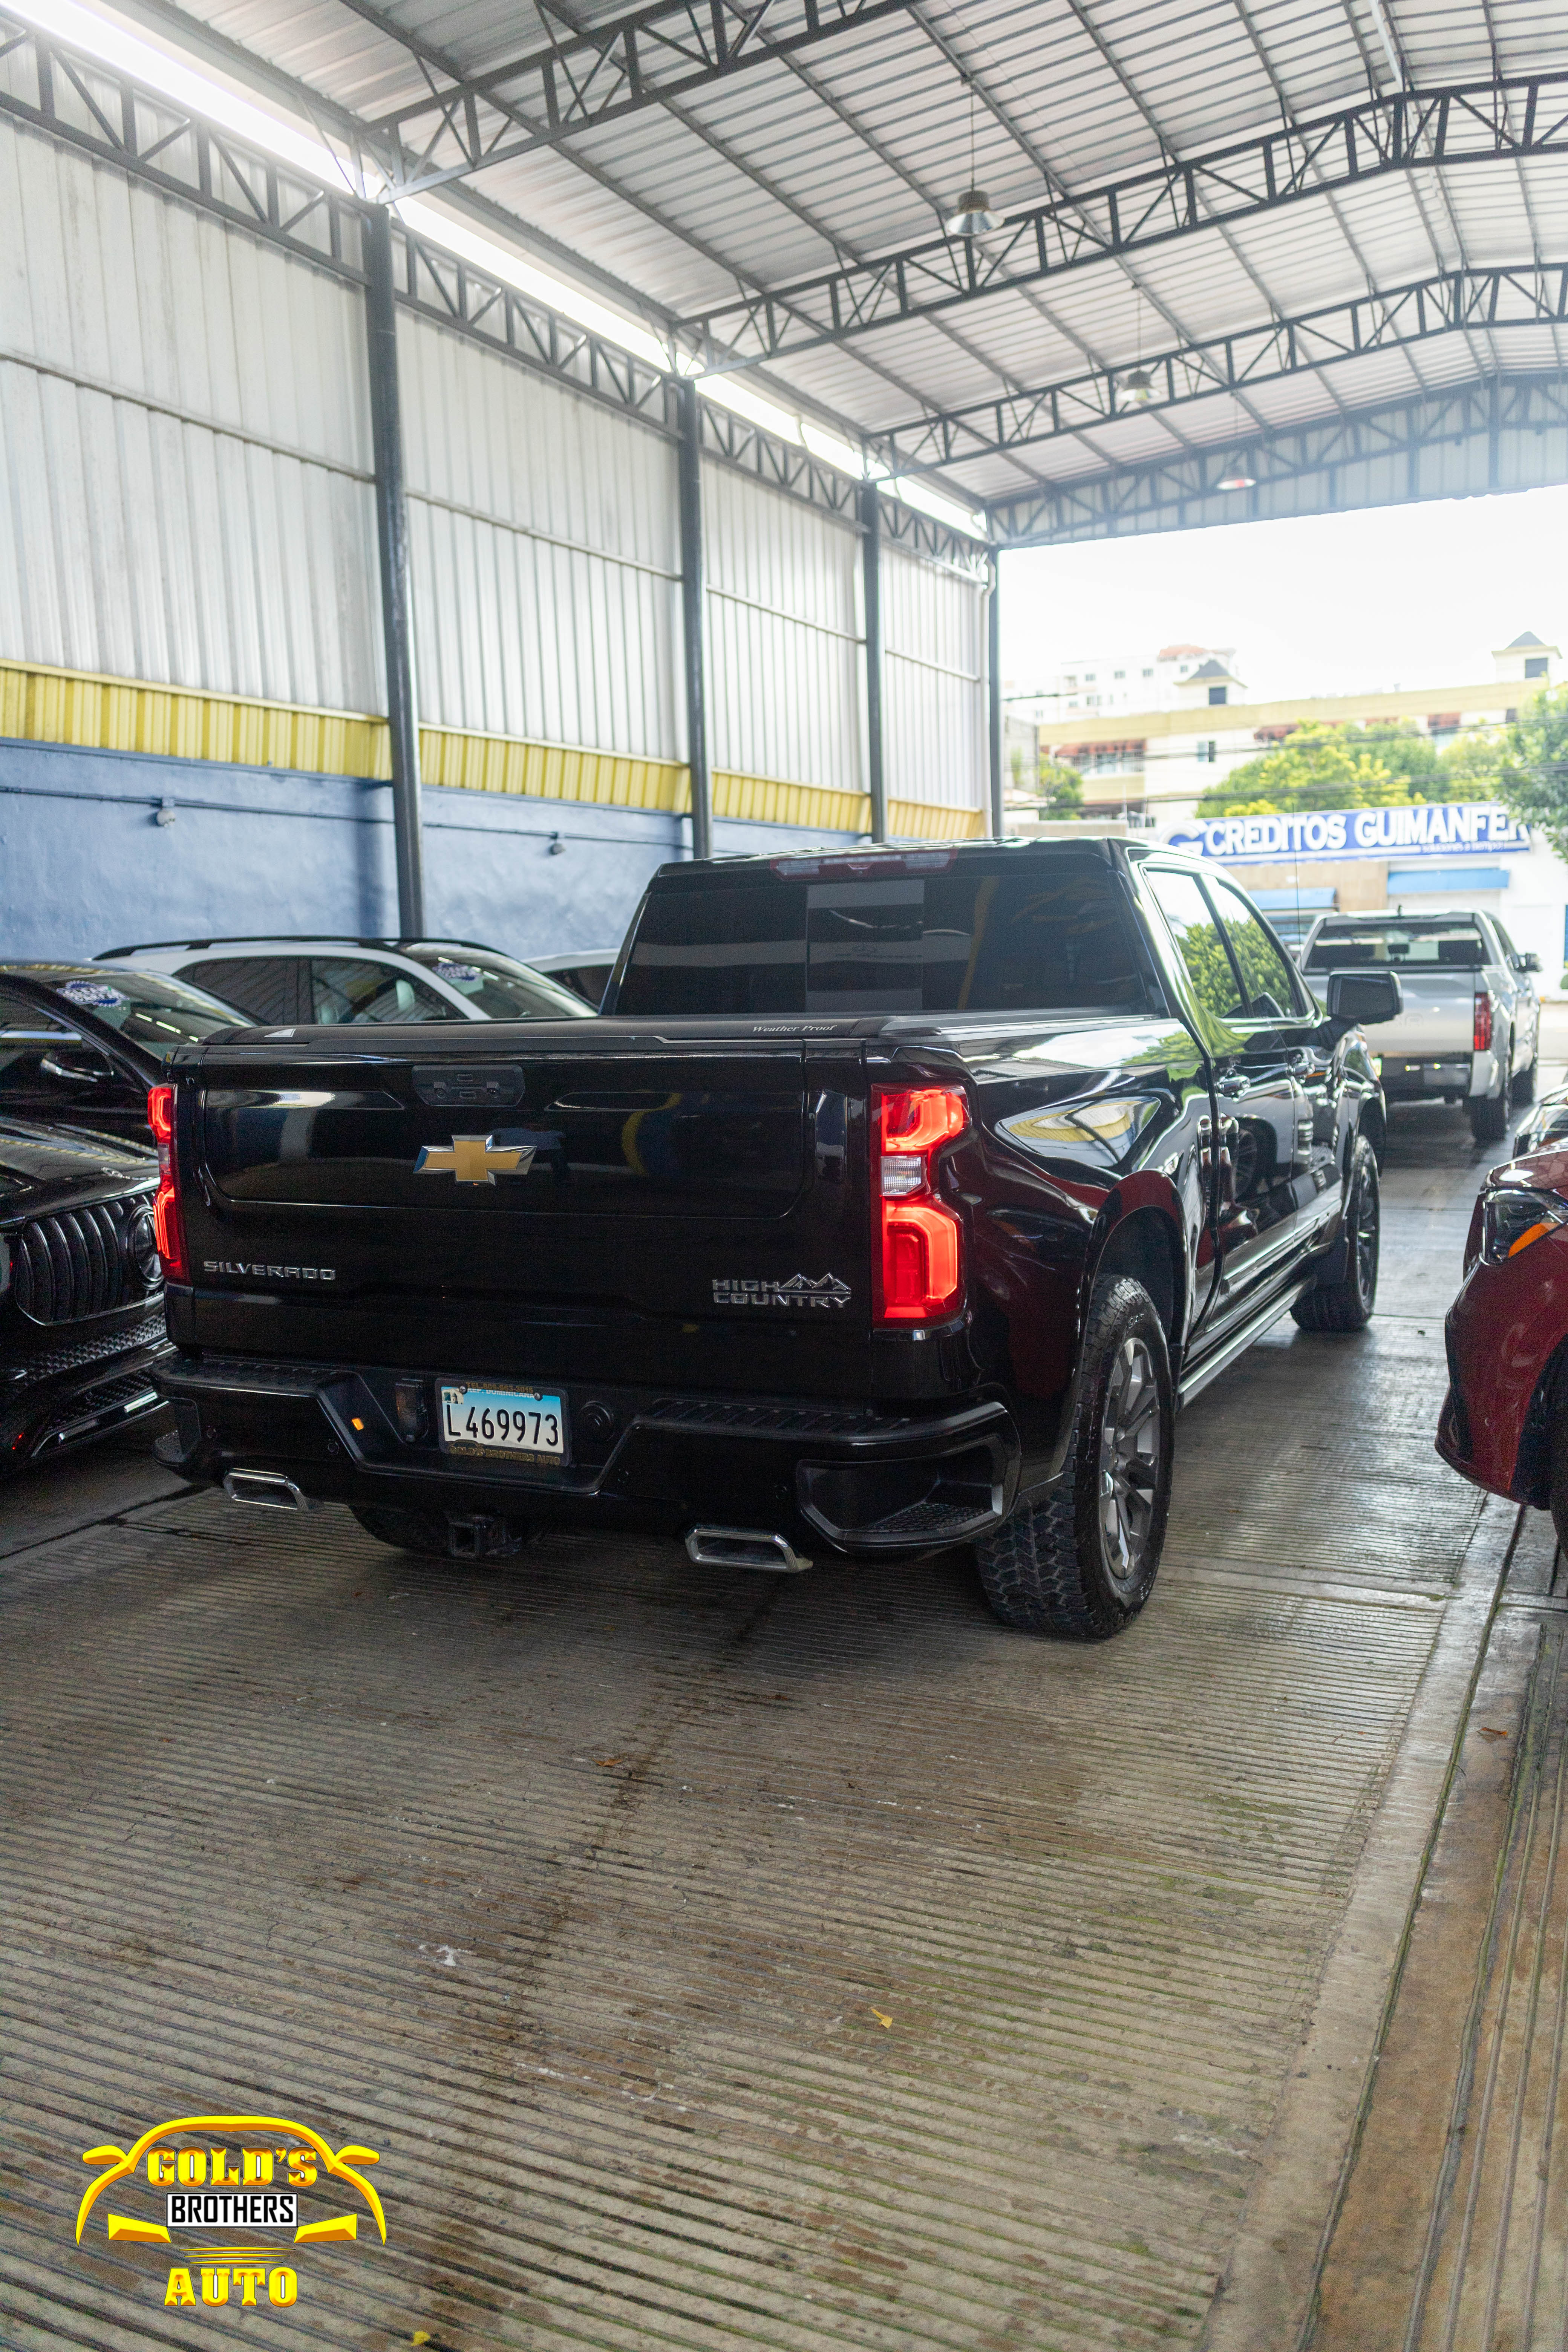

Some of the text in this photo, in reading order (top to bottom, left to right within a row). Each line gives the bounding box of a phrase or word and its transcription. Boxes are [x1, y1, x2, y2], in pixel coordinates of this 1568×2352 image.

[1205, 813, 1347, 856] CREDITOS
[204, 1261, 337, 1280] SILVERADO
[712, 1279, 779, 1292] HIGH
[714, 1292, 851, 1308] COUNTRY
[447, 1404, 559, 1446] L469973
[485, 1449, 535, 1462] BROTHERS
[536, 1455, 561, 1466] AUTO
